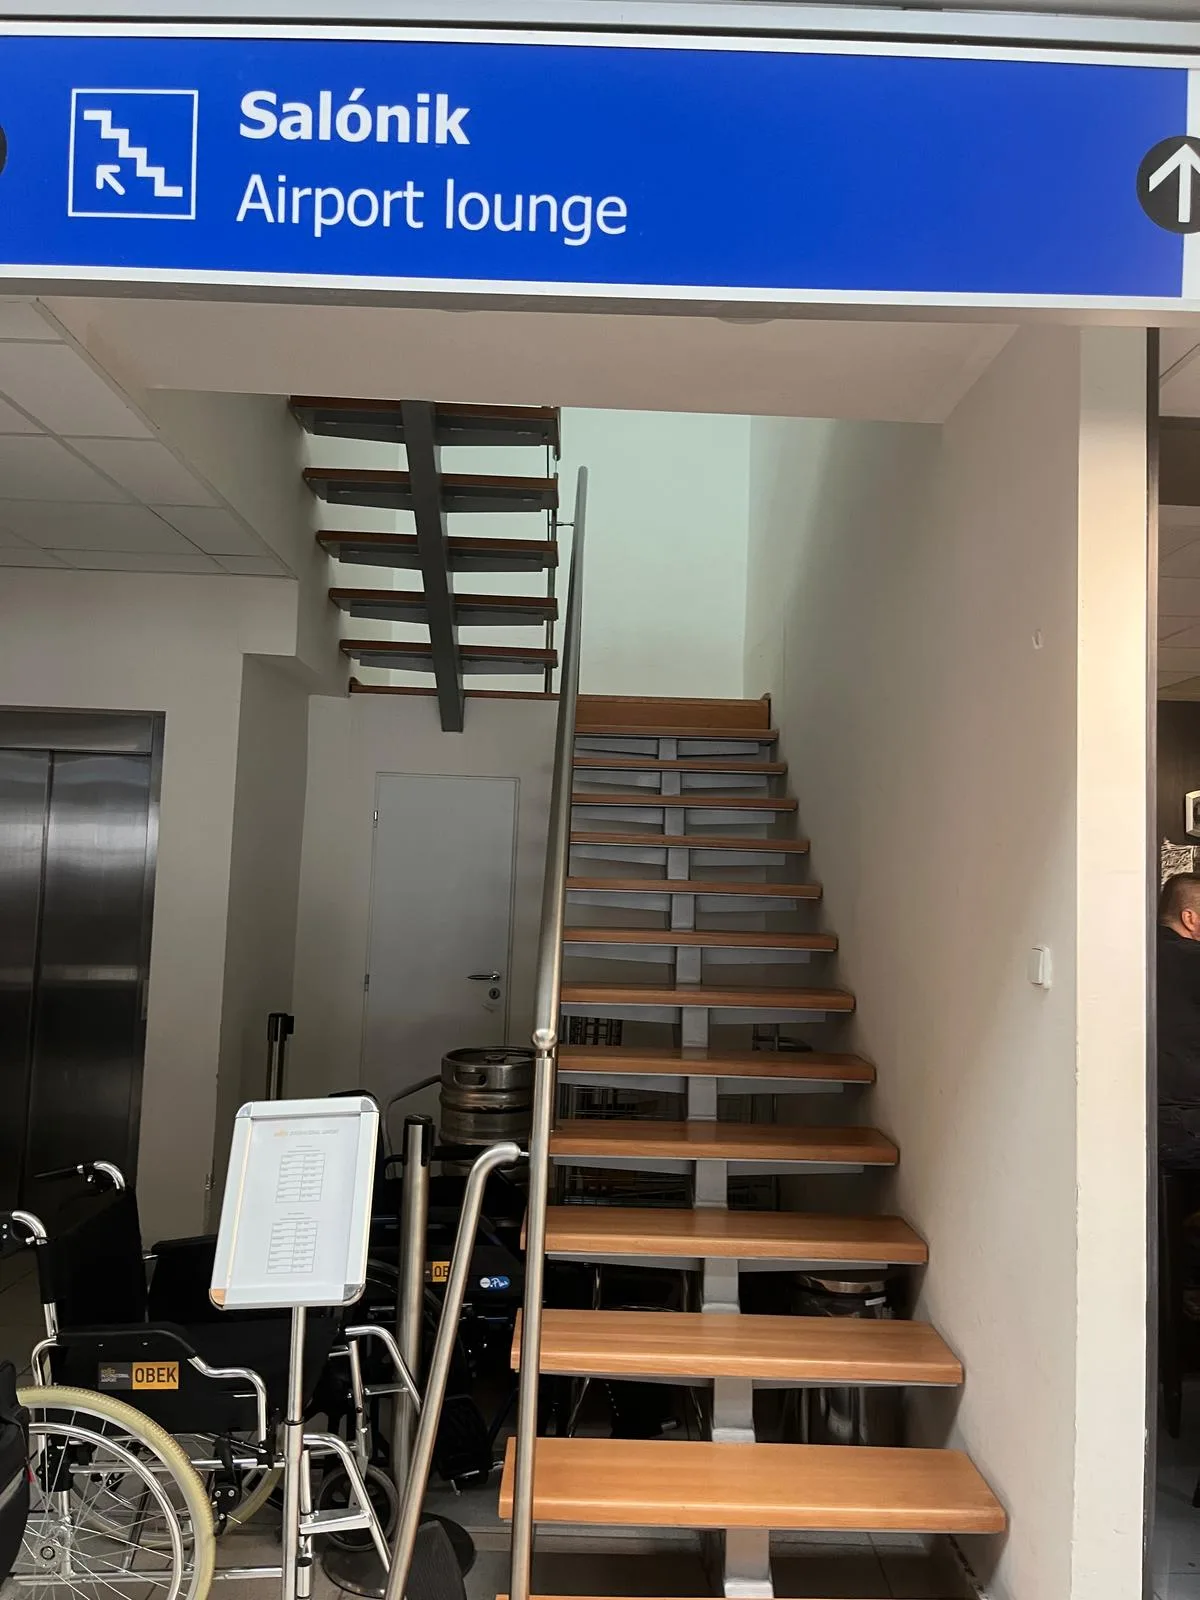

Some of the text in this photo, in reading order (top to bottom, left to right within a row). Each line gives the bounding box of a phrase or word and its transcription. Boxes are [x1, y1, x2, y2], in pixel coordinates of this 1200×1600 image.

[239, 87, 471, 145] Salónik
[237, 174, 628, 247] Airport lounge
[135, 1367, 177, 1383] OBEK
